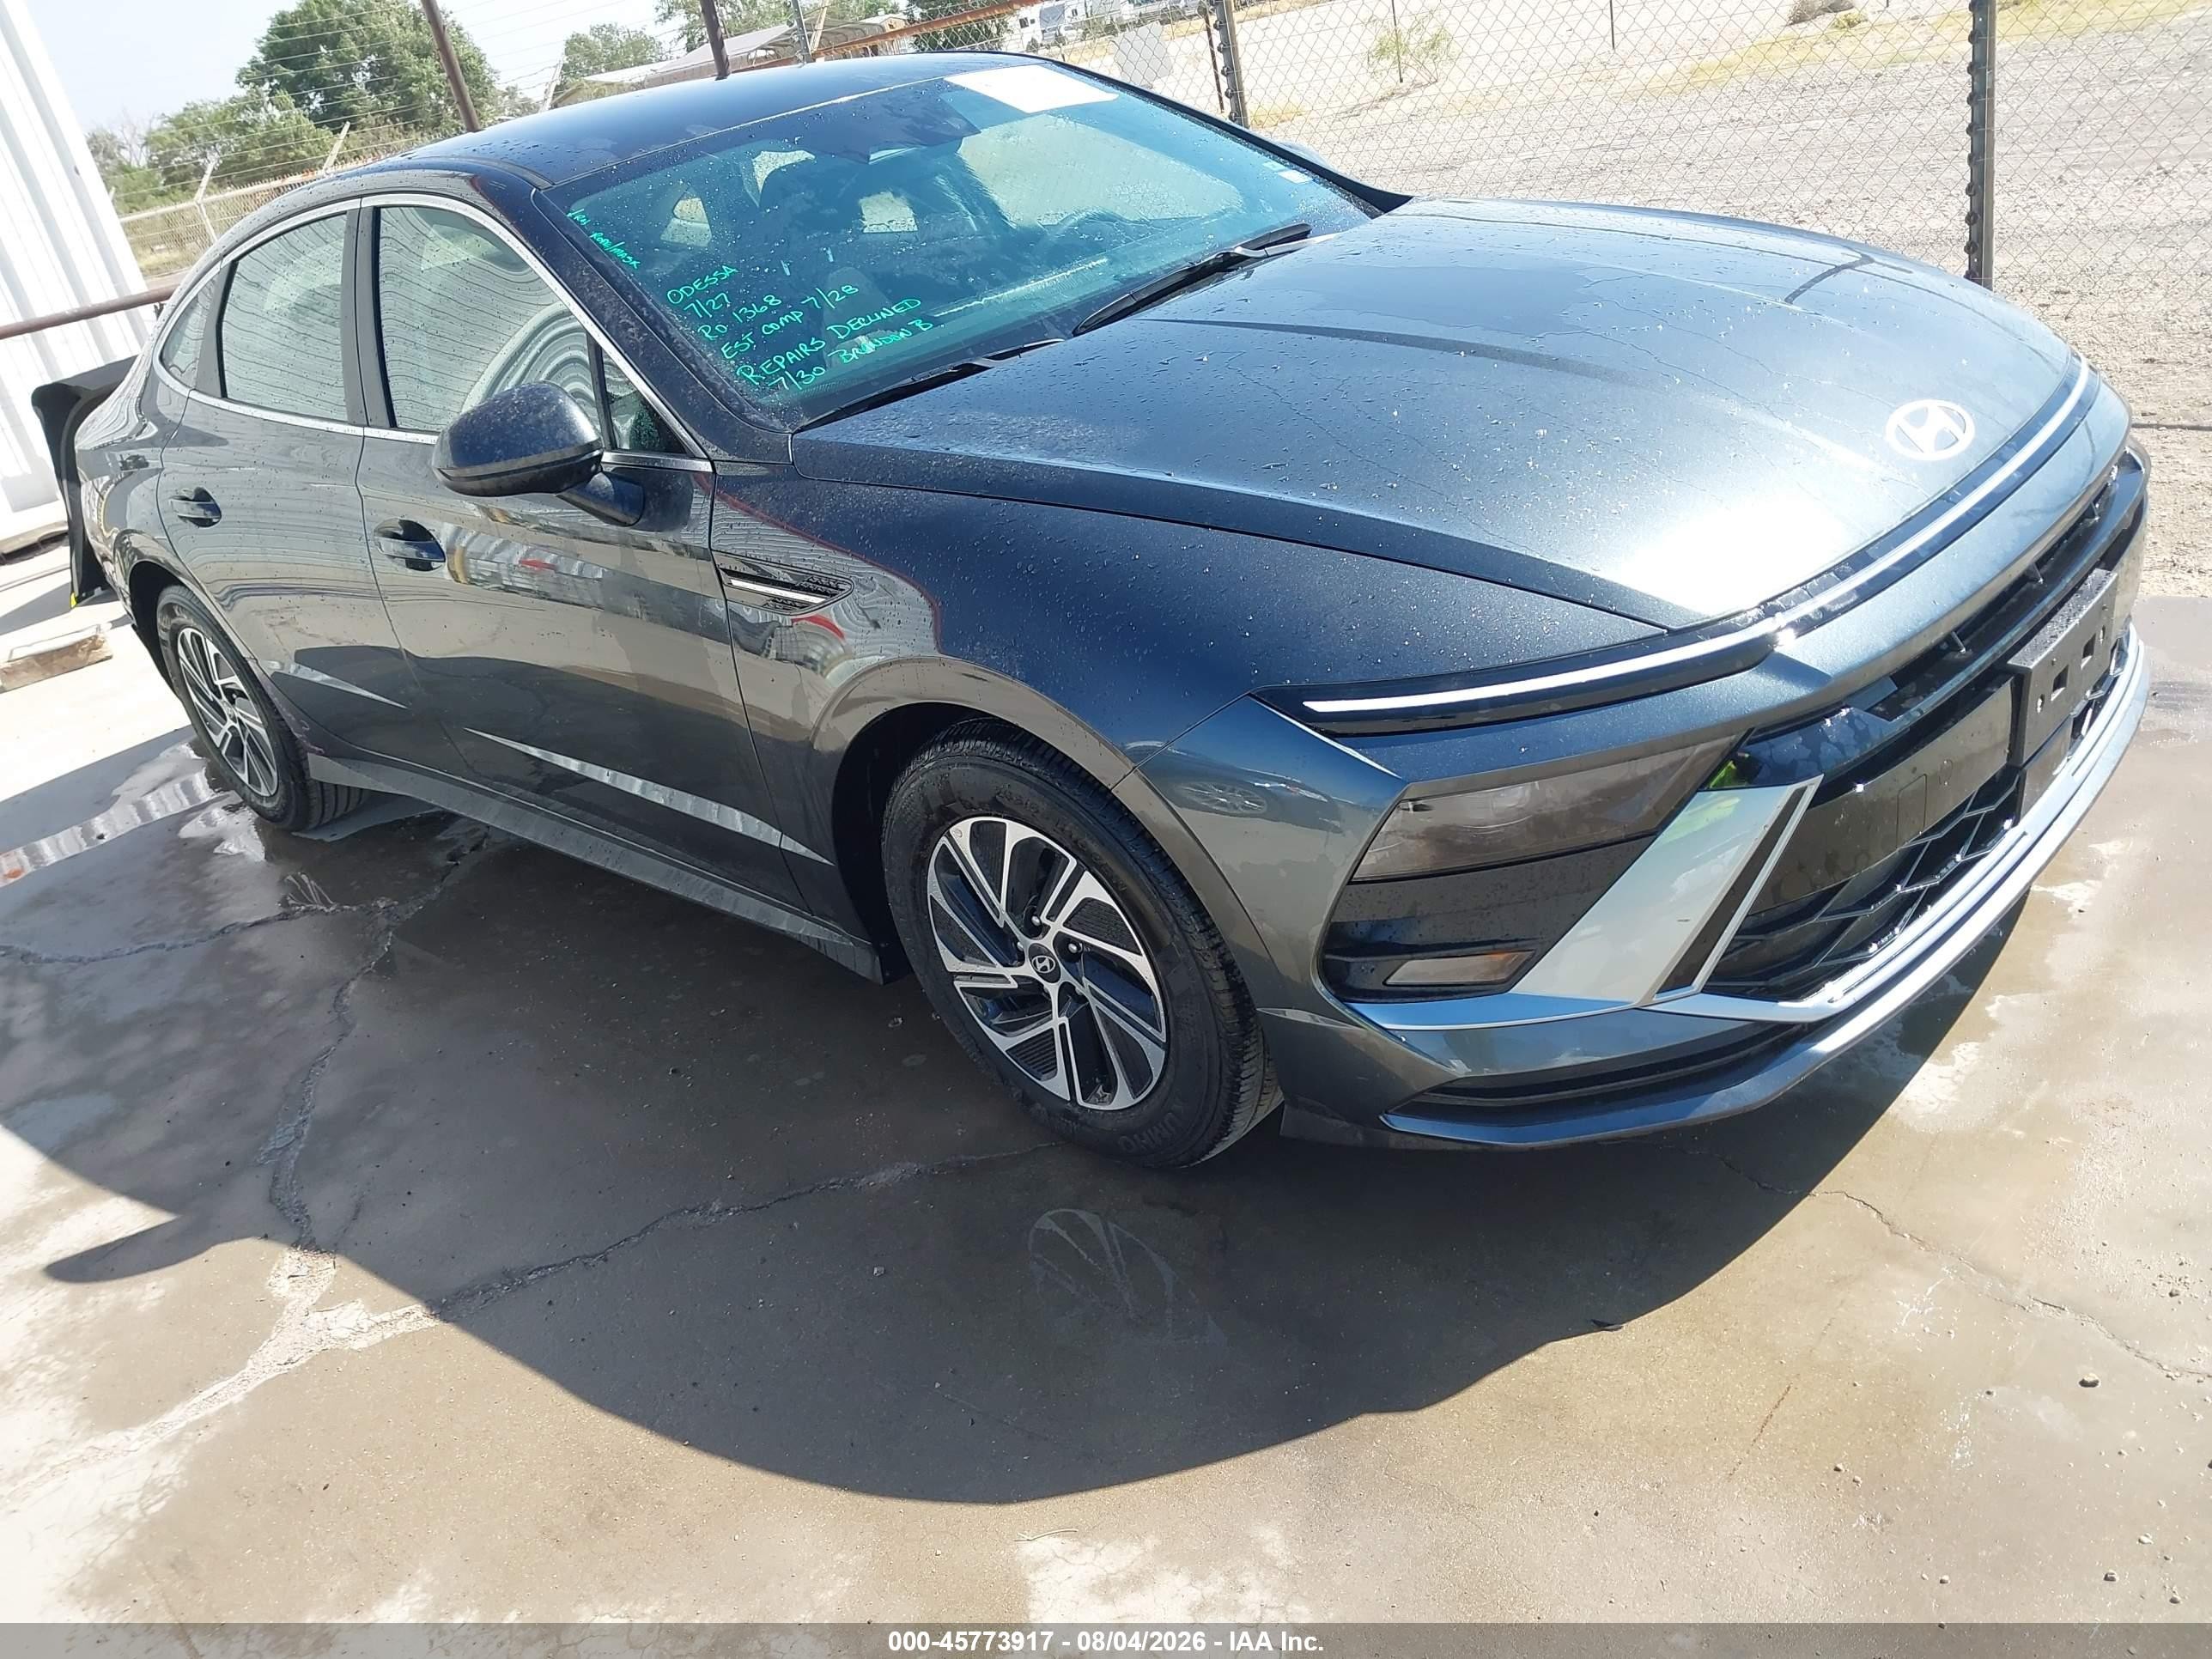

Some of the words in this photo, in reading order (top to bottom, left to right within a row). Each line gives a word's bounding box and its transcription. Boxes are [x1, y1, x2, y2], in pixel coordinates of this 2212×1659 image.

[667, 265, 738, 304] ODESSA
[684, 293, 731, 318] 7/27
[732, 295, 782, 323] 1368
[720, 331, 755, 359] EST
[800, 284, 859, 312] 7/28
[737, 337, 826, 386] REPAIRS
[826, 299, 921, 339] DECLINED
[768, 366, 826, 391] 7/30
[908, 319, 933, 331] B
